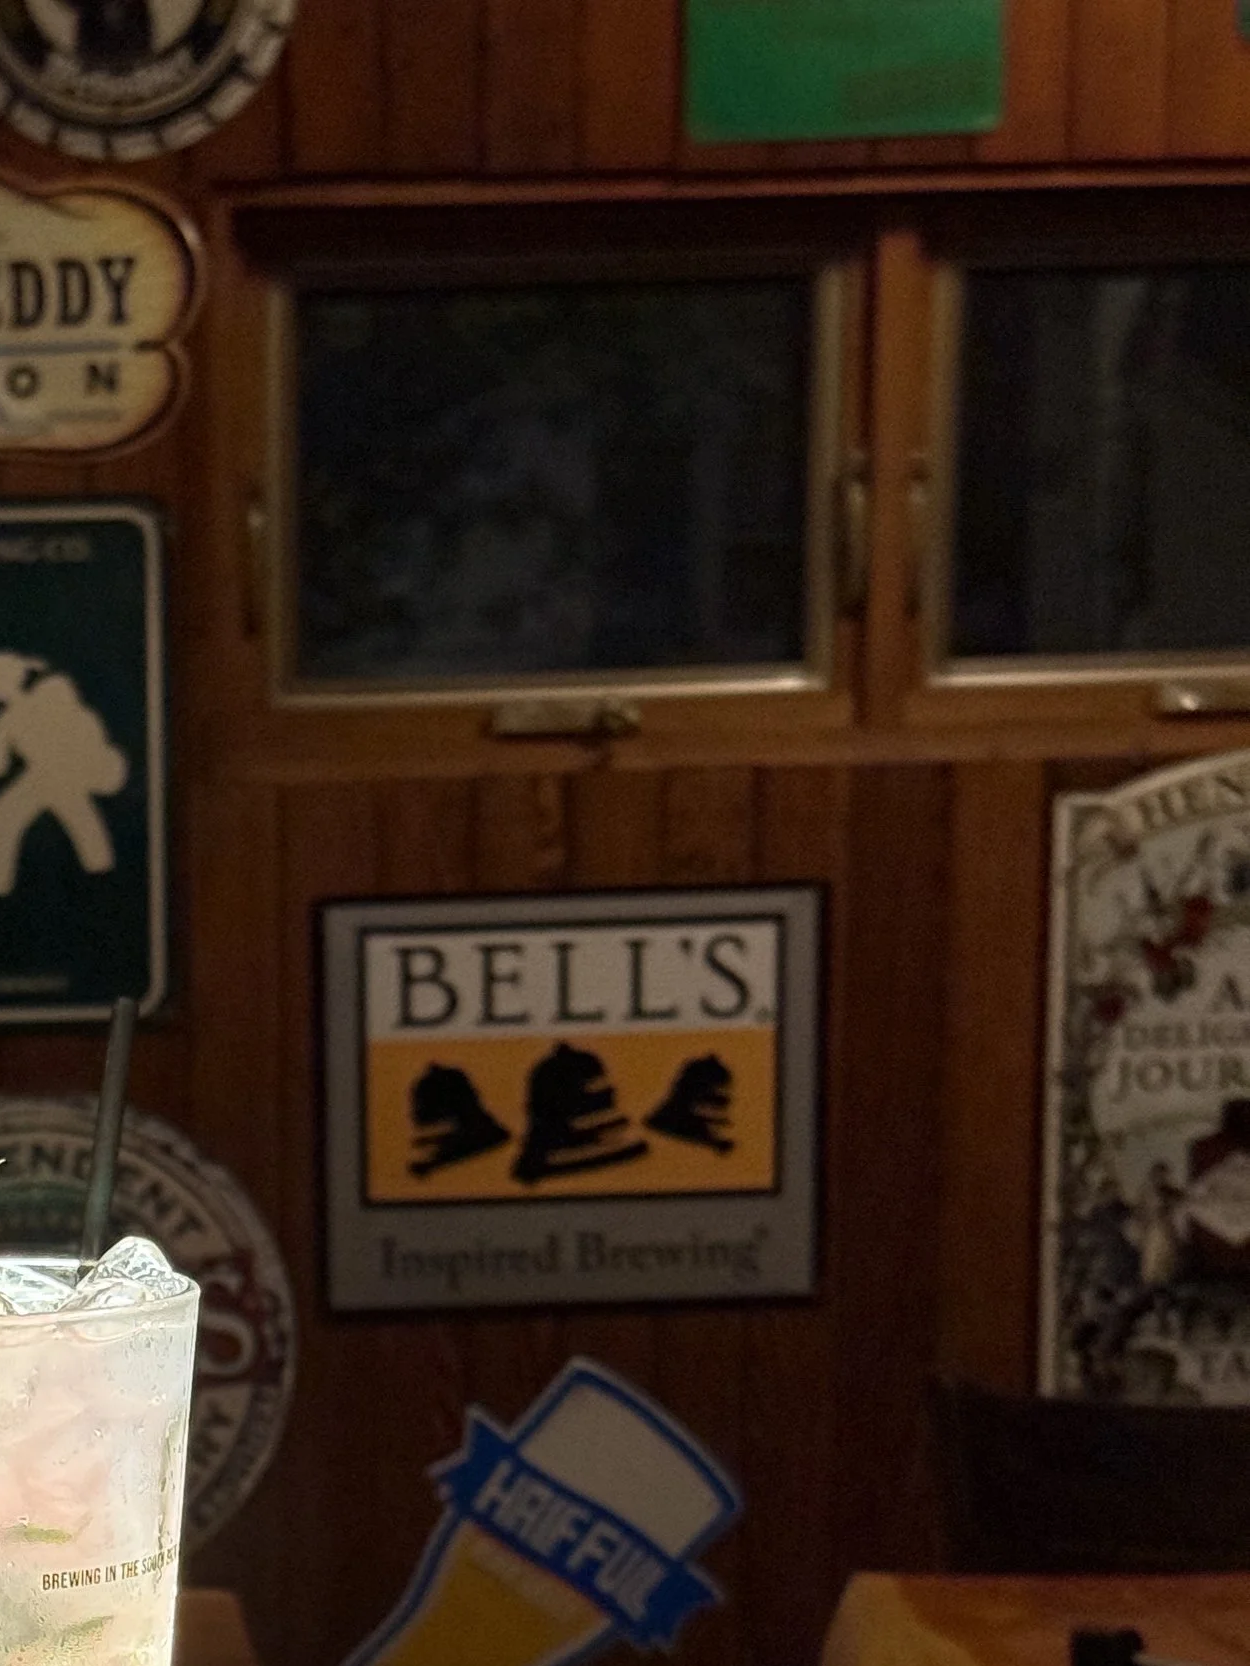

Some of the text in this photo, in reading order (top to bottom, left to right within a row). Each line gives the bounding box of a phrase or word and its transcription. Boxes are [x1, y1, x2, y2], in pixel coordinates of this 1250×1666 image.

[392, 931, 754, 1029] BELL'S
[378, 1230, 763, 1293] Inspired Brewing
[42, 1567, 101, 1591] BREWING
[105, 1565, 117, 1583] IN
[121, 1559, 140, 1580] THE
